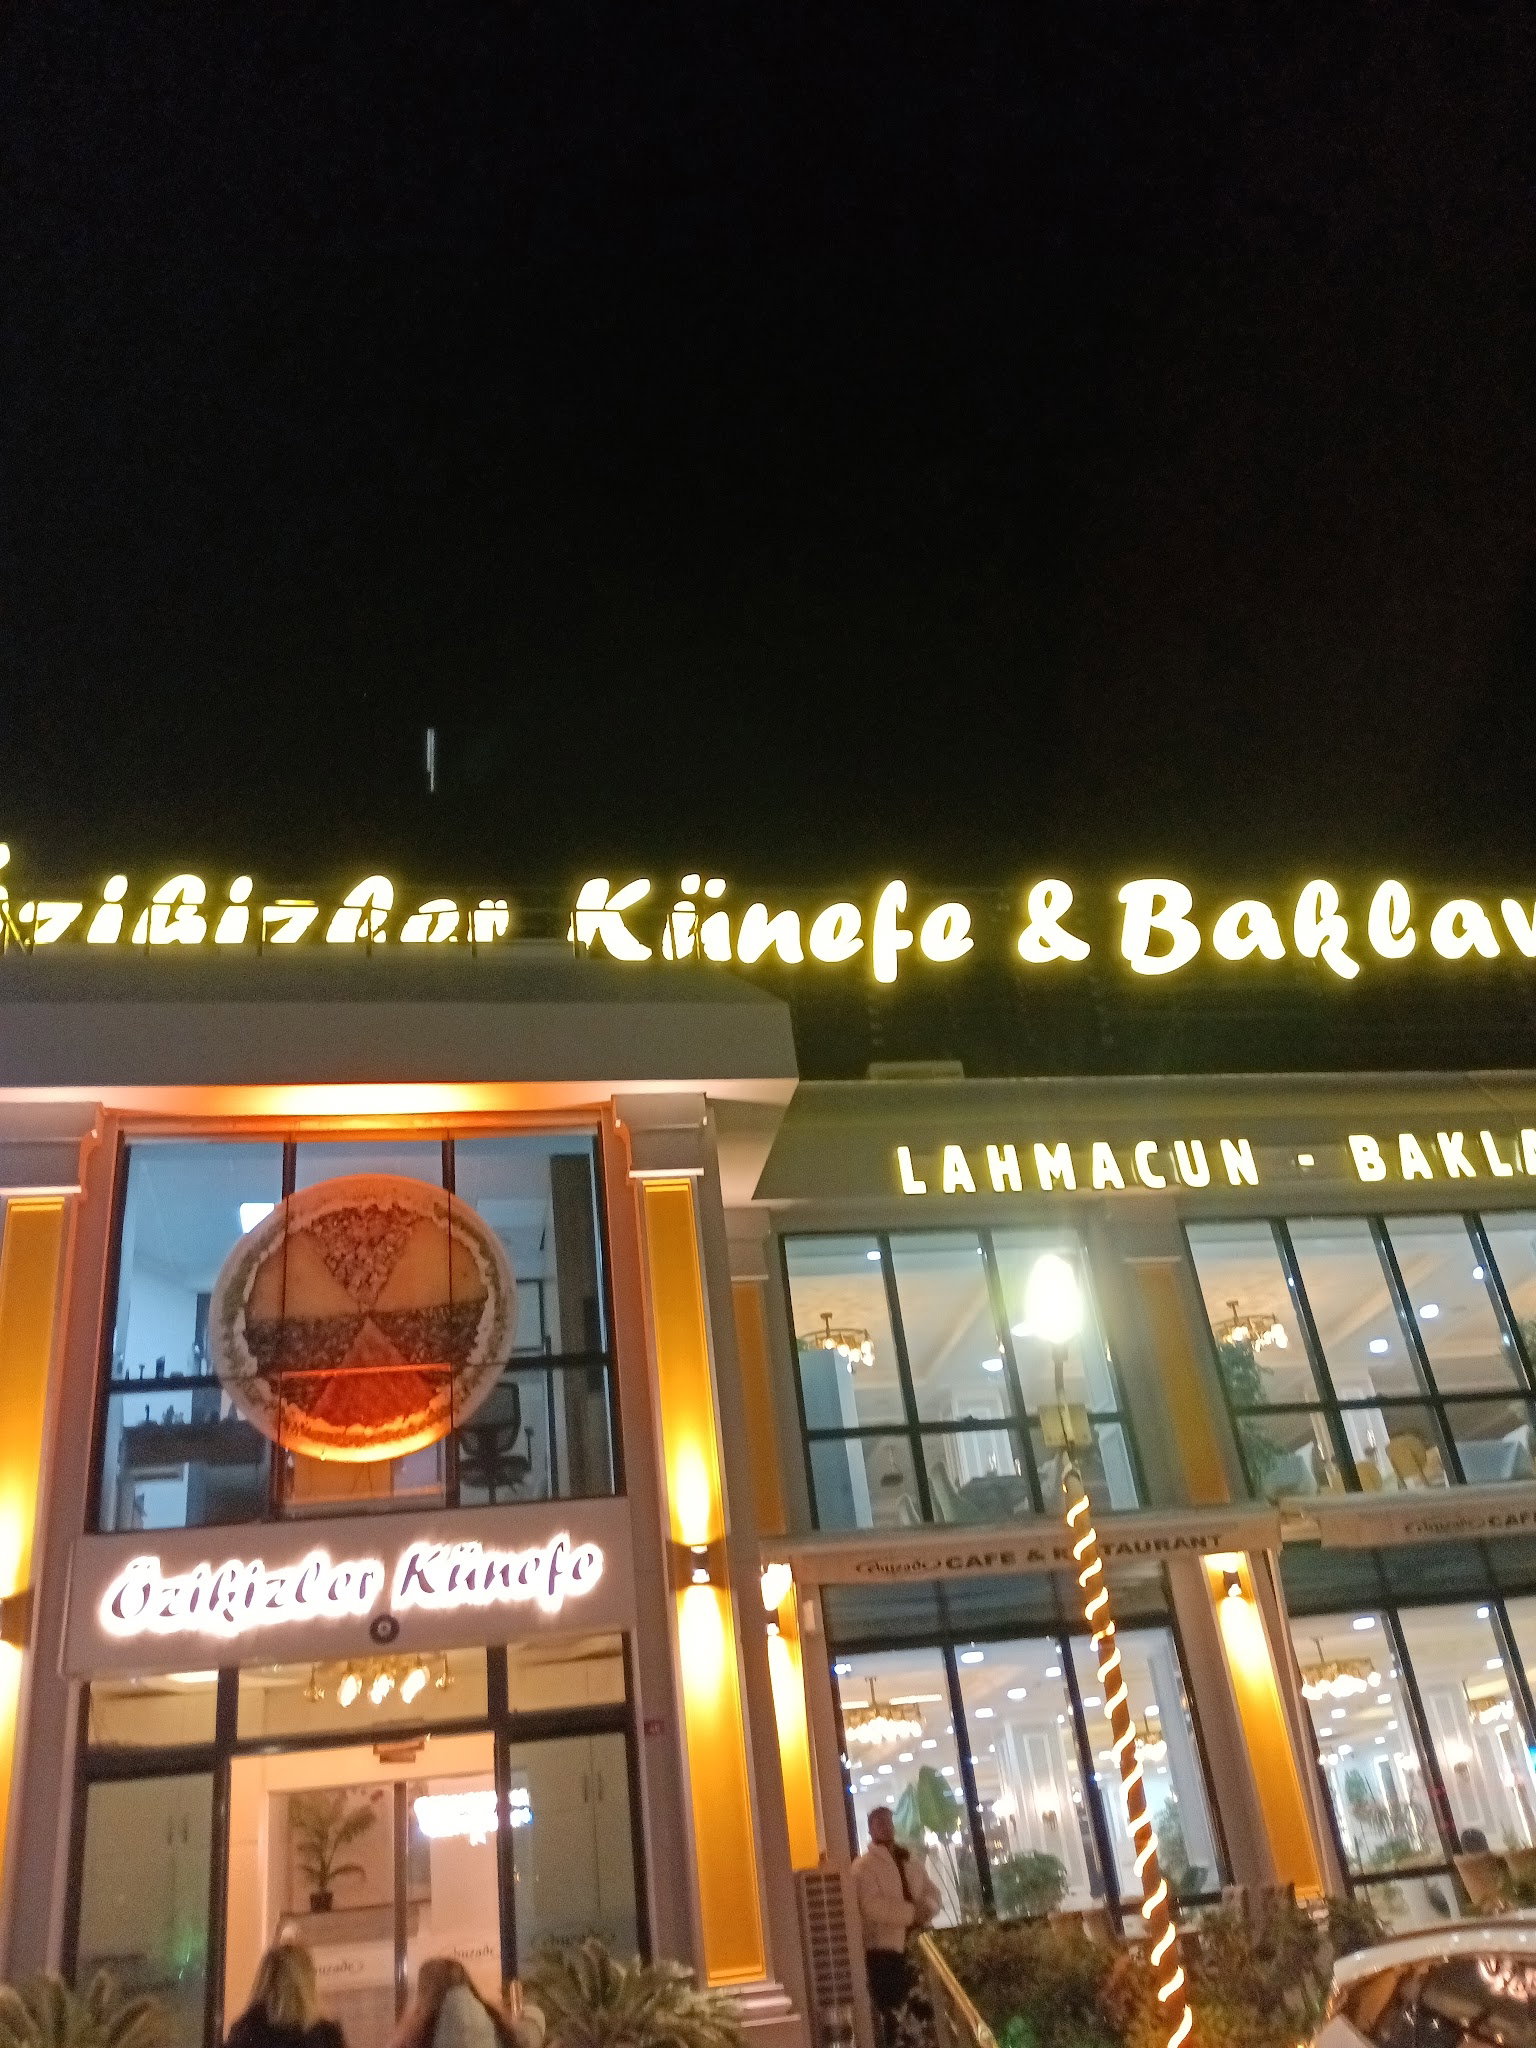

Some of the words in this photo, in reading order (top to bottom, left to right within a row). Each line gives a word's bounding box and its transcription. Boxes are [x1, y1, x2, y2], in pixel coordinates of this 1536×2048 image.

[567, 874, 973, 983] Künefe
[1018, 879, 1091, 963] &
[897, 1139, 1259, 1195] LAHMACUN
[395, 1535, 599, 1605] Künefe
[945, 1552, 1016, 1570] CAFE
[1027, 1548, 1045, 1563] &
[1053, 1533, 1220, 1561] RTAURANT
